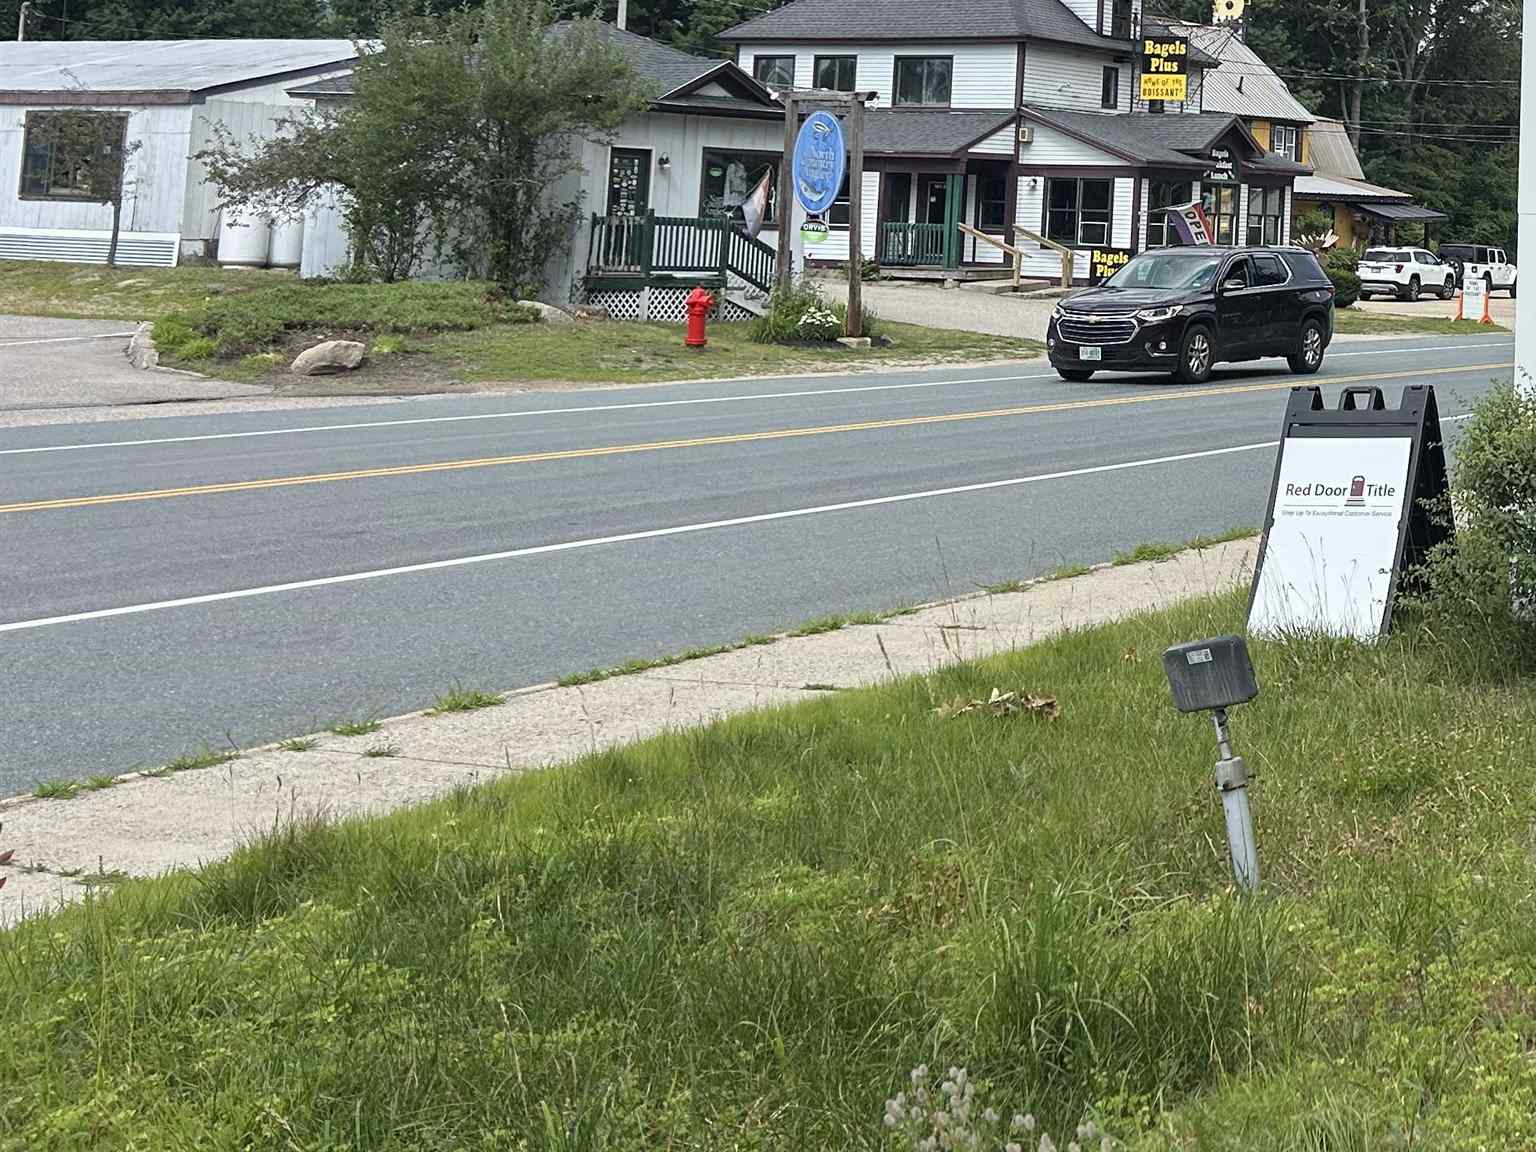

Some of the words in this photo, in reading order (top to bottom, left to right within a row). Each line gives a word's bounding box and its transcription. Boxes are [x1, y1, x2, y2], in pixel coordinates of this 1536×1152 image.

[1144, 40, 1186, 57] Bagels
[1150, 58, 1178, 72] Plus
[1185, 210, 1207, 240] OPE
[1093, 250, 1129, 265] Bagels
[1285, 483, 1312, 497] Red
[1315, 483, 1348, 497] Door
[1367, 483, 1396, 497] Title
